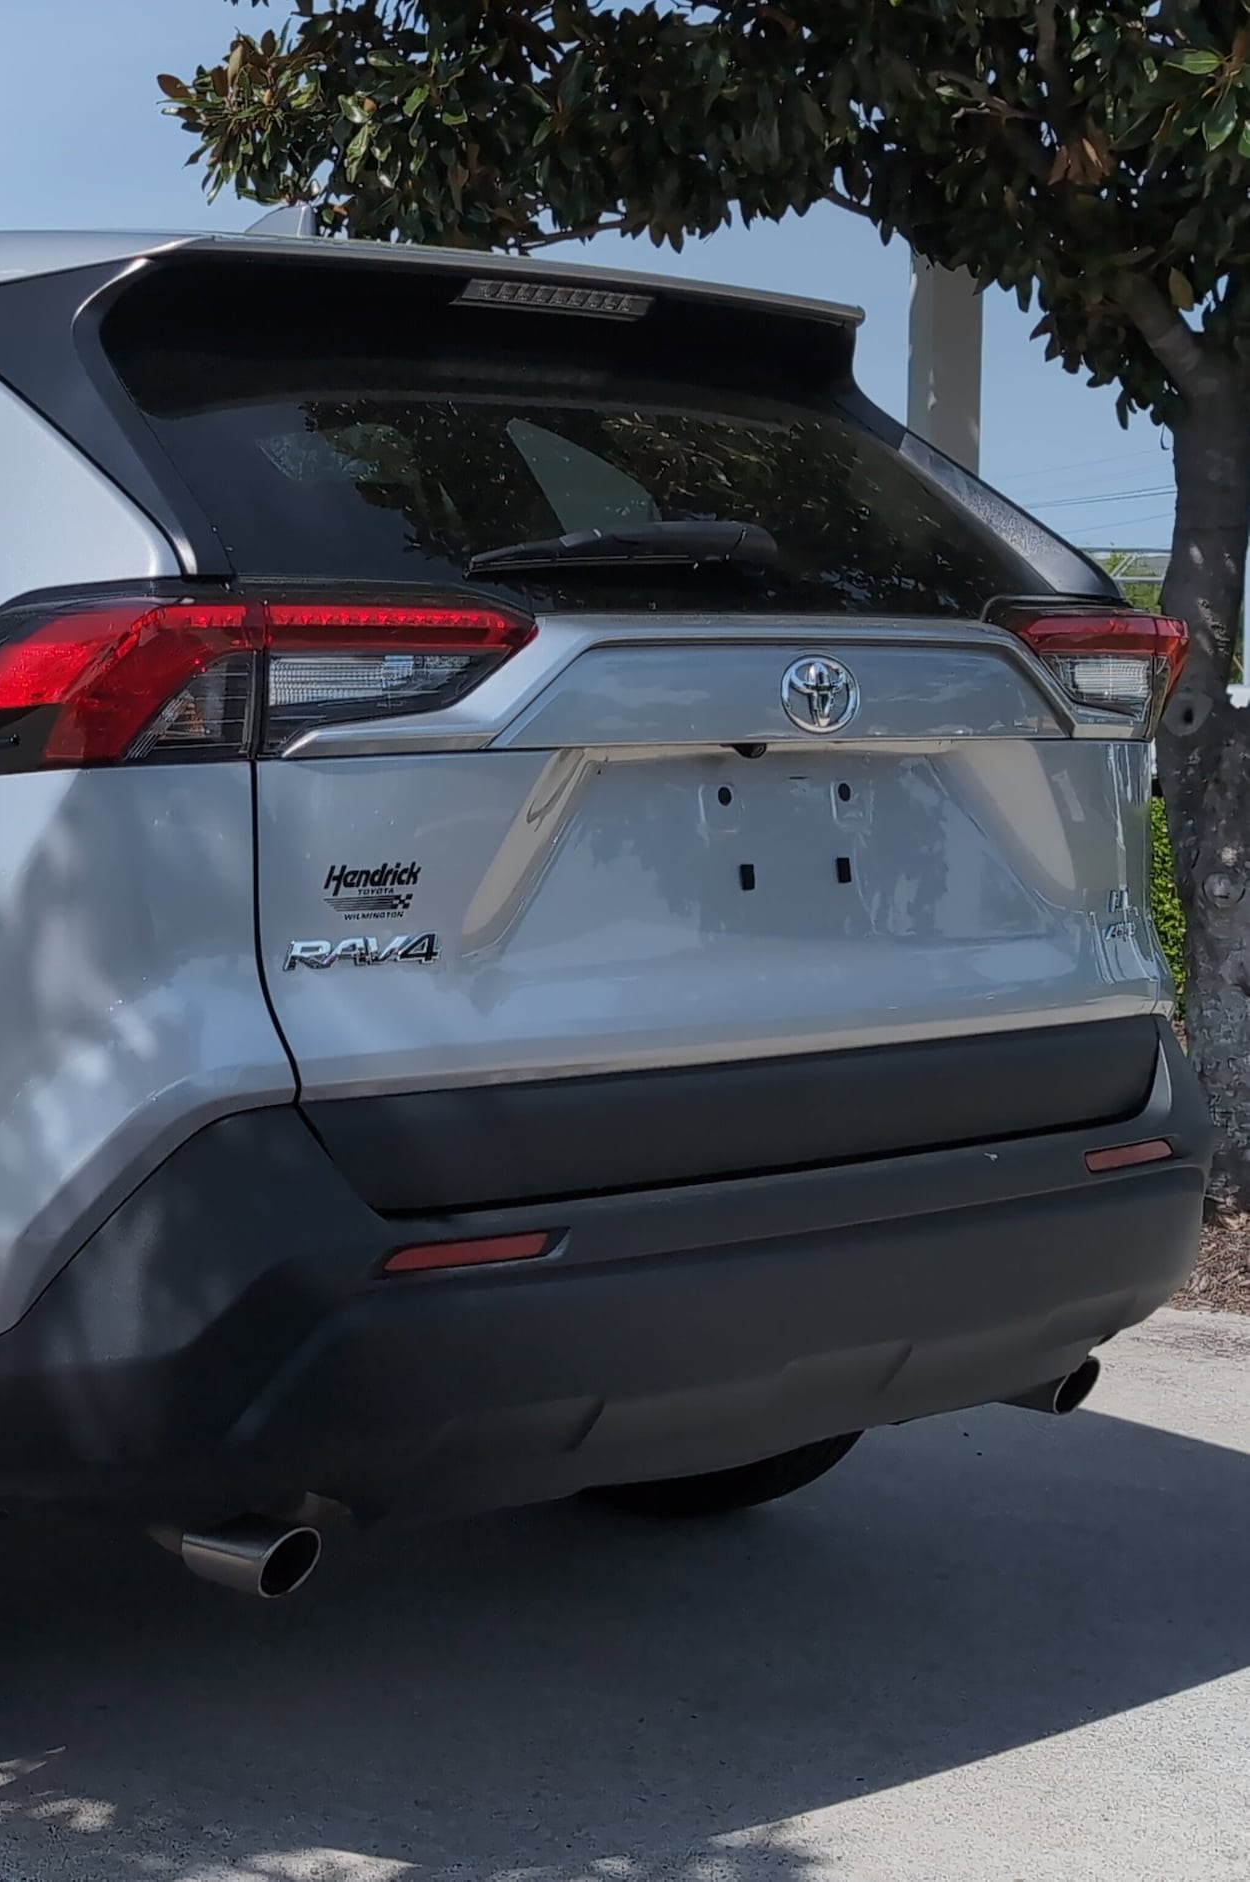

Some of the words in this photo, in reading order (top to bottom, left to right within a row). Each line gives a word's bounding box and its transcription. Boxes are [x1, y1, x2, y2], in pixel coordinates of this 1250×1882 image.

[324, 861, 421, 896] Hendrick
[358, 887, 395, 895] TOYOTA
[344, 911, 404, 921] WILMINGTON
[283, 930, 442, 971] RAV4
